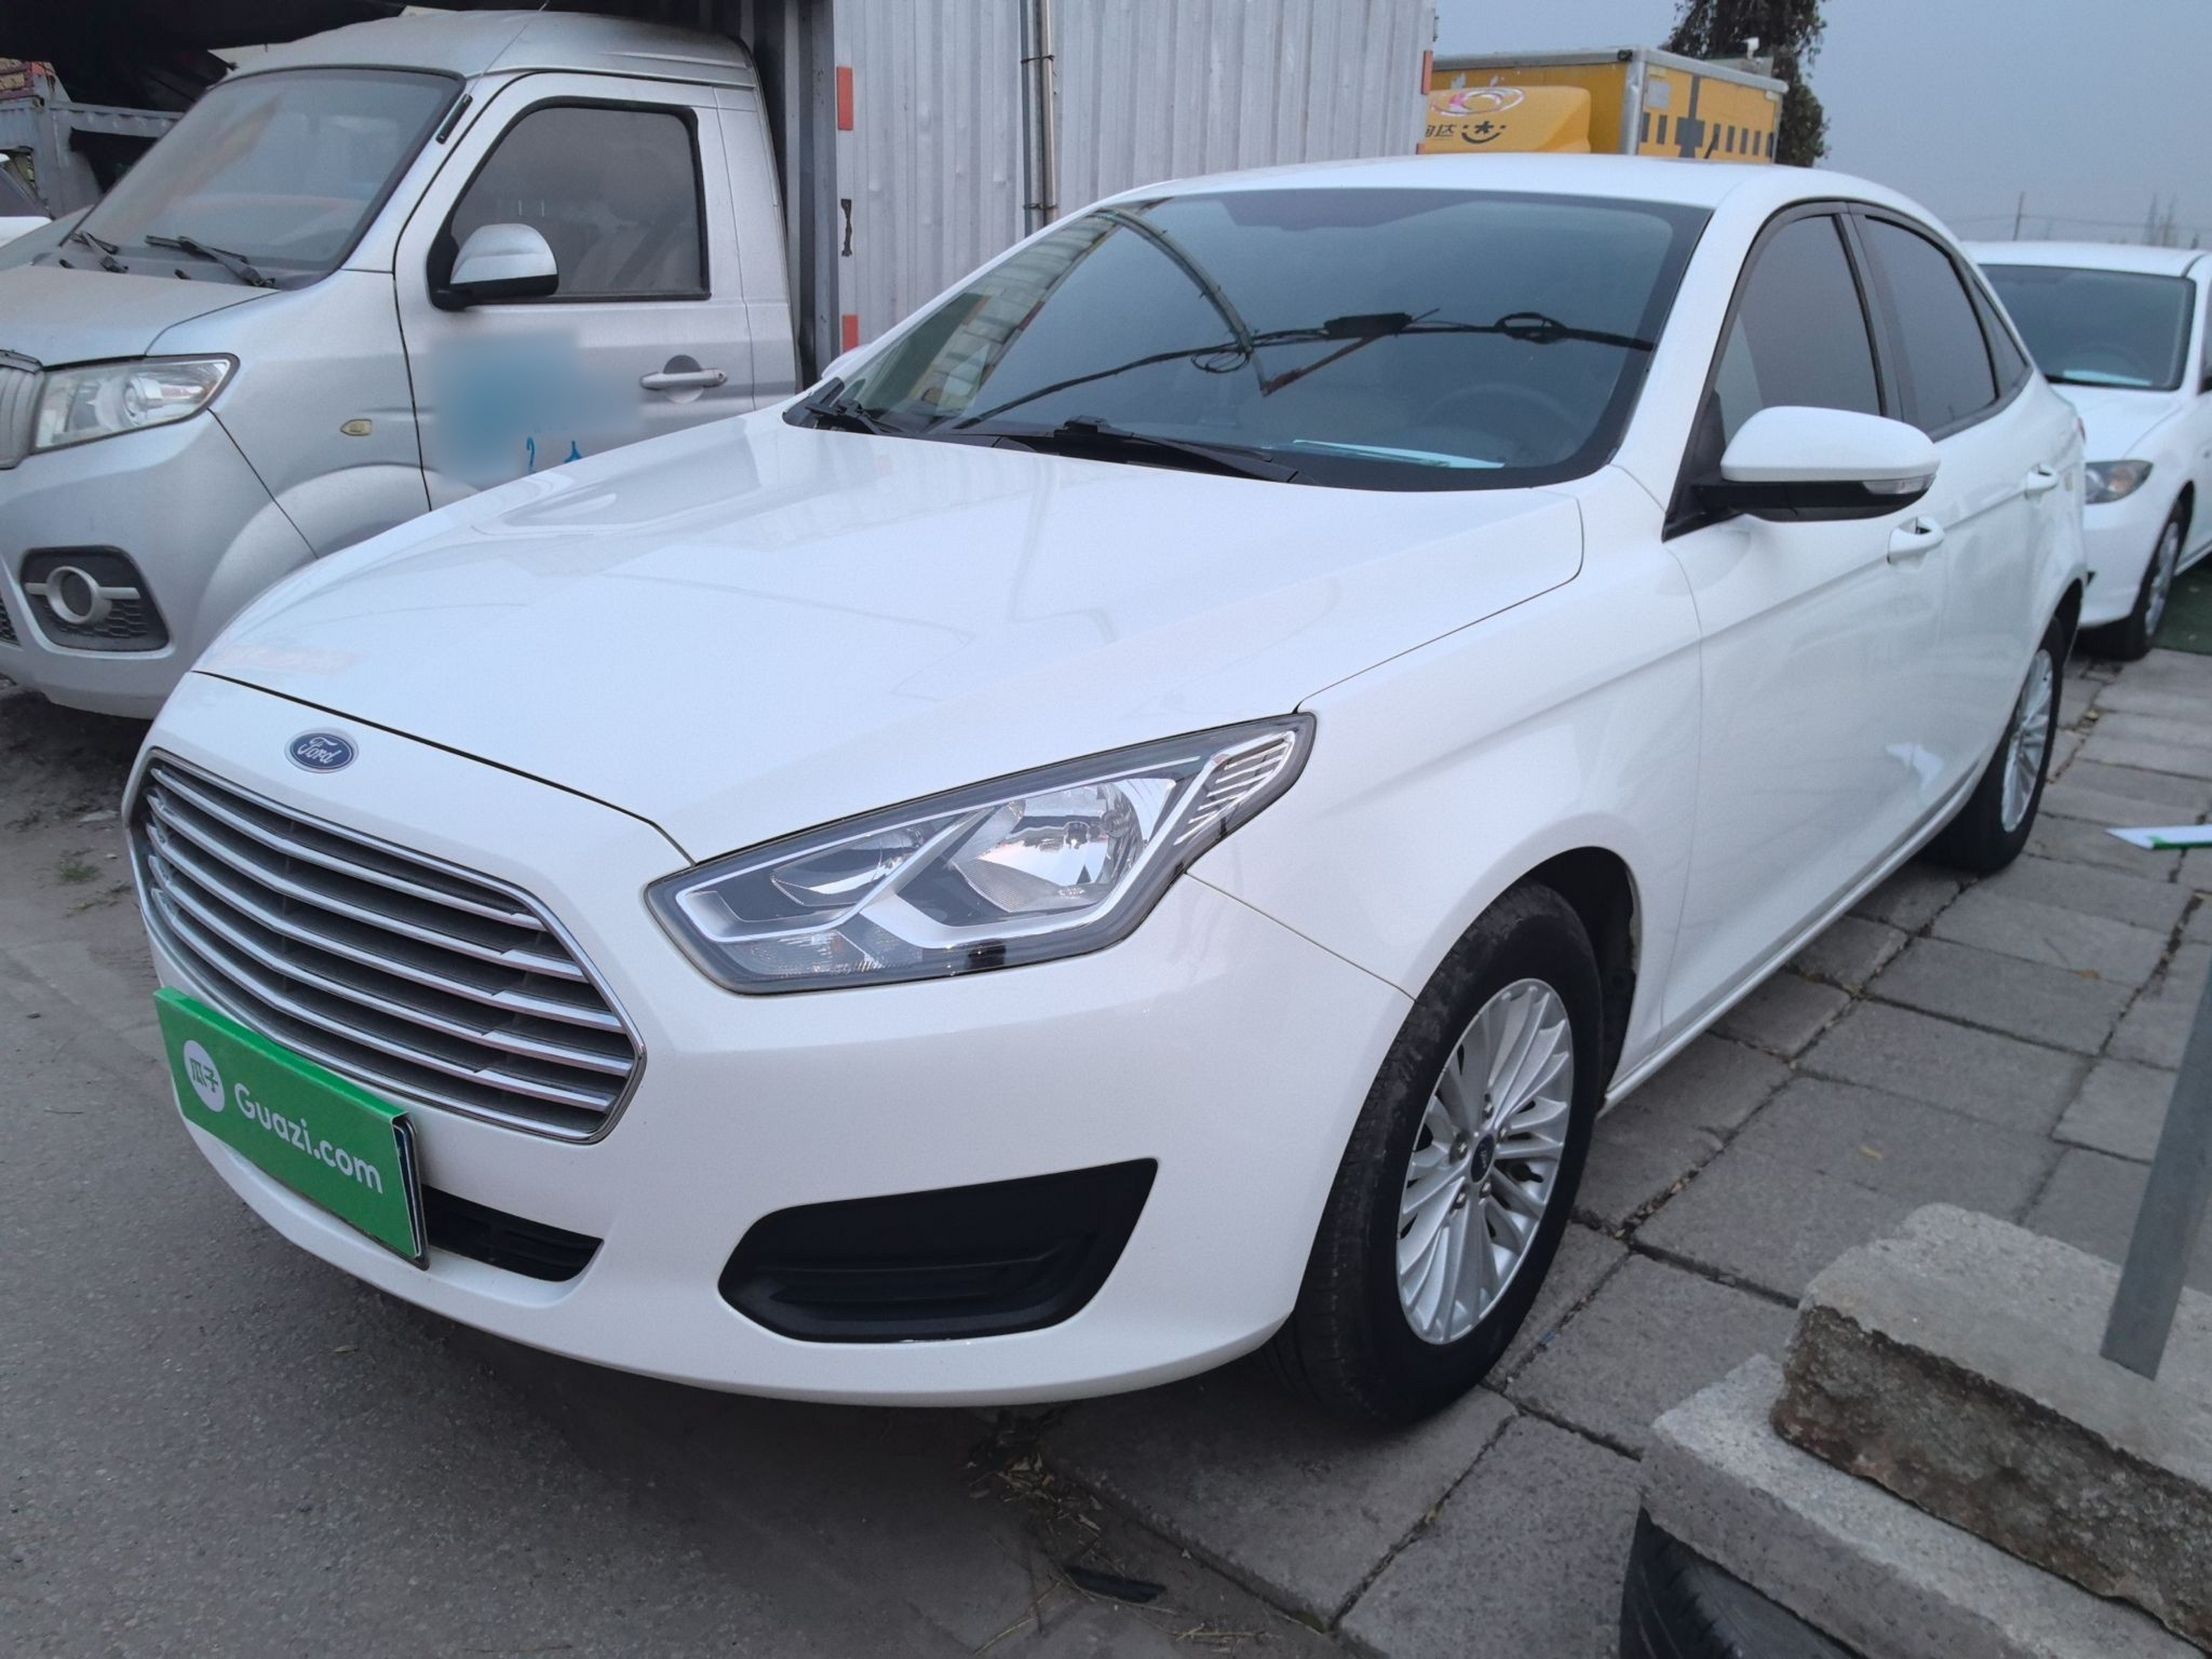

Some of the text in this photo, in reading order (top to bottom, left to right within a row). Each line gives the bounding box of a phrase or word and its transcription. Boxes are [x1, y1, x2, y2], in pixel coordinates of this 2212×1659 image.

[297, 737, 342, 764] Ford
[189, 1057, 219, 1093] 瓜子
[234, 1082, 384, 1194] Guazi.com
